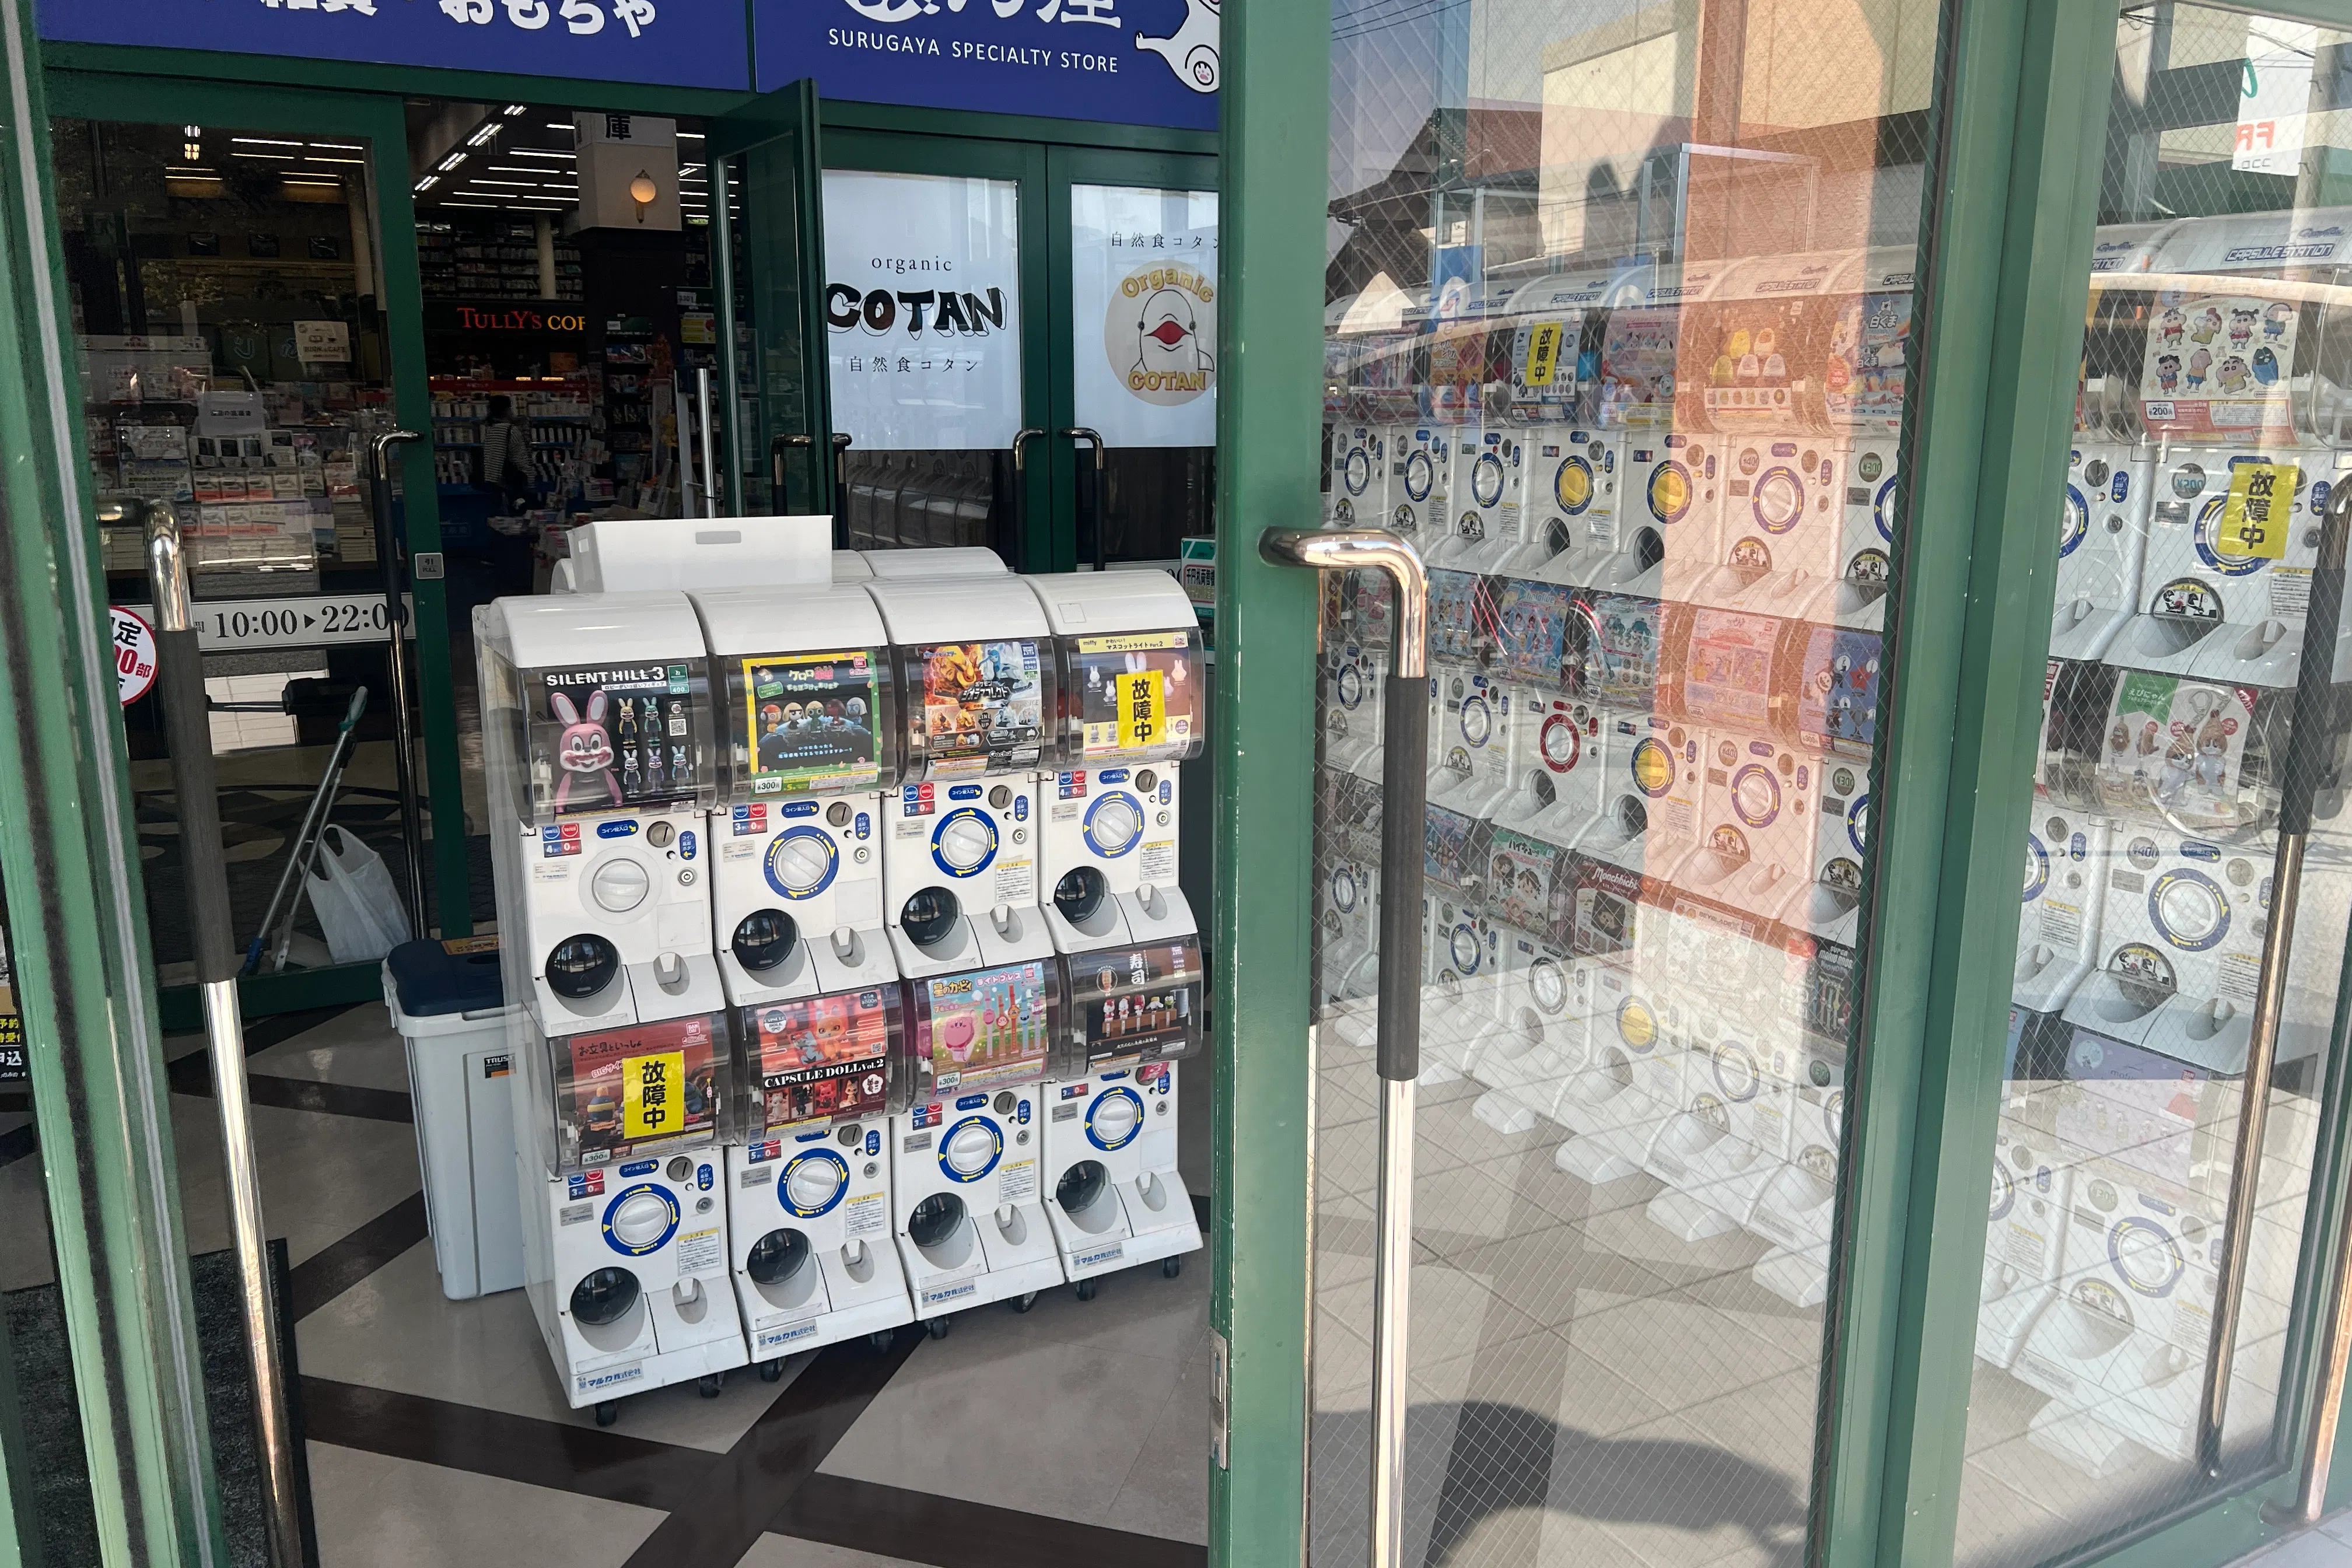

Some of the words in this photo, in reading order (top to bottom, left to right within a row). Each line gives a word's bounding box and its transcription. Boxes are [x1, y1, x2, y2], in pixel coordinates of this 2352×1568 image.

[828, 28, 940, 56] SURUGAYA
[952, 41, 1052, 67] SPECIALTY
[1060, 52, 1118, 73] STORE
[2225, 247, 2280, 261] CAPSULE
[2281, 244, 2333, 257] STATION
[871, 257, 952, 274] organic
[1121, 268, 1214, 303] Organic
[1883, 273, 1915, 285] CAPSUL
[457, 307, 542, 329] TULLY'S
[825, 283, 1007, 340] COTAN
[1869, 314, 1898, 328] 白くま
[849, 355, 979, 373] 自然食コタン
[1857, 356, 1878, 368] 白くま
[1128, 370, 1206, 391] COTAN
[2239, 470, 2276, 550] 故障中
[1525, 591, 1556, 604] hololive
[216, 609, 298, 639] 10:00
[1106, 642, 1148, 650] マスコットライト
[547, 671, 608, 687] SILENT
[612, 668, 650, 682] HILL
[651, 666, 665, 680] 3
[961, 685, 1009, 701] ジオラマコレクト
[2129, 687, 2166, 701] えびにゃん
[1132, 678, 1152, 742] 故障中
[734, 822, 741, 831] 3
[545, 845, 553, 854] 4
[1591, 867, 1638, 890] Monchhichi
[1129, 953, 1145, 985] 寿司
[976, 970, 1022, 987] ライトブレス
[933, 979, 974, 998] 星のカービィ
[578, 1040, 642, 1056] お文具といっしょ
[591, 1059, 624, 1079] BIGサイ
[764, 1069, 824, 1088] CAPSULE
[826, 1062, 862, 1078] DOLL
[642, 1060, 666, 1129] 故障中
[914, 1118, 919, 1127] 3
[750, 1150, 757, 1160] 5
[572, 1188, 578, 1196] 3
